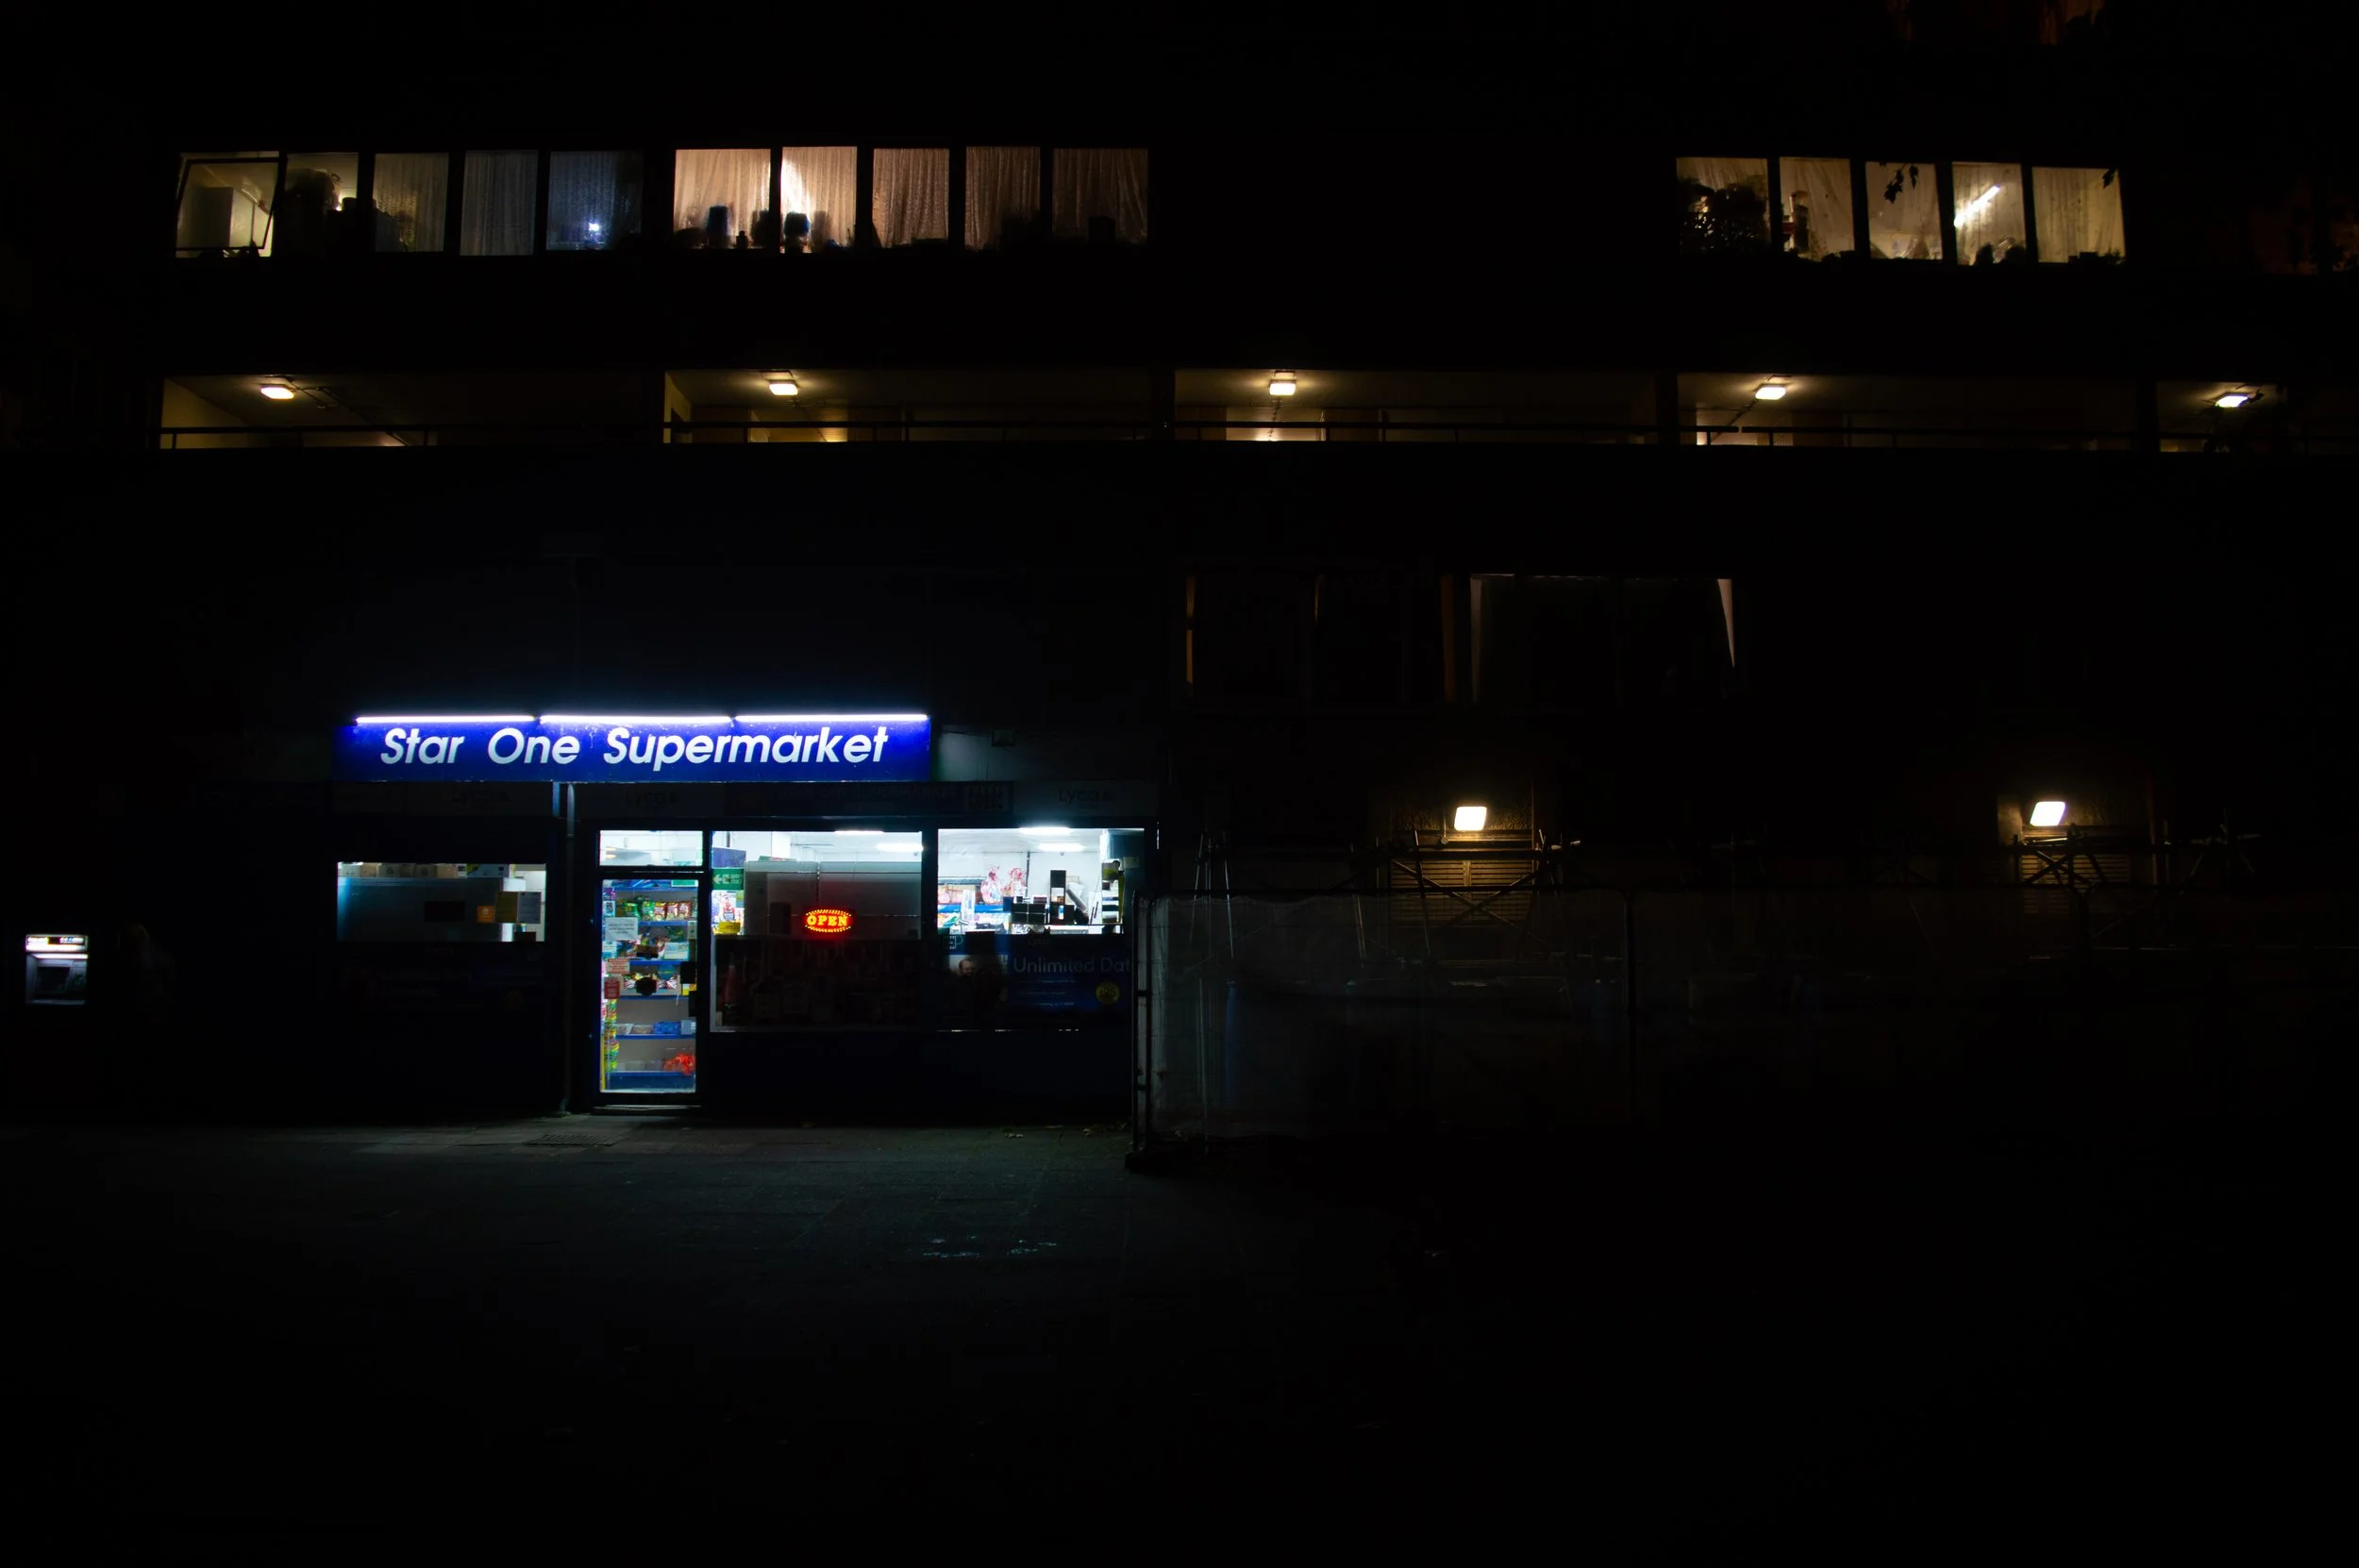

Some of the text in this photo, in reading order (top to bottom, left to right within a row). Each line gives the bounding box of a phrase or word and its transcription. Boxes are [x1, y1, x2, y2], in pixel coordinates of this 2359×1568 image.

[380, 726, 888, 772] Star One Supermarket
[807, 914, 848, 926] OPEN
[1013, 956, 1131, 974] Unlimited Dat
